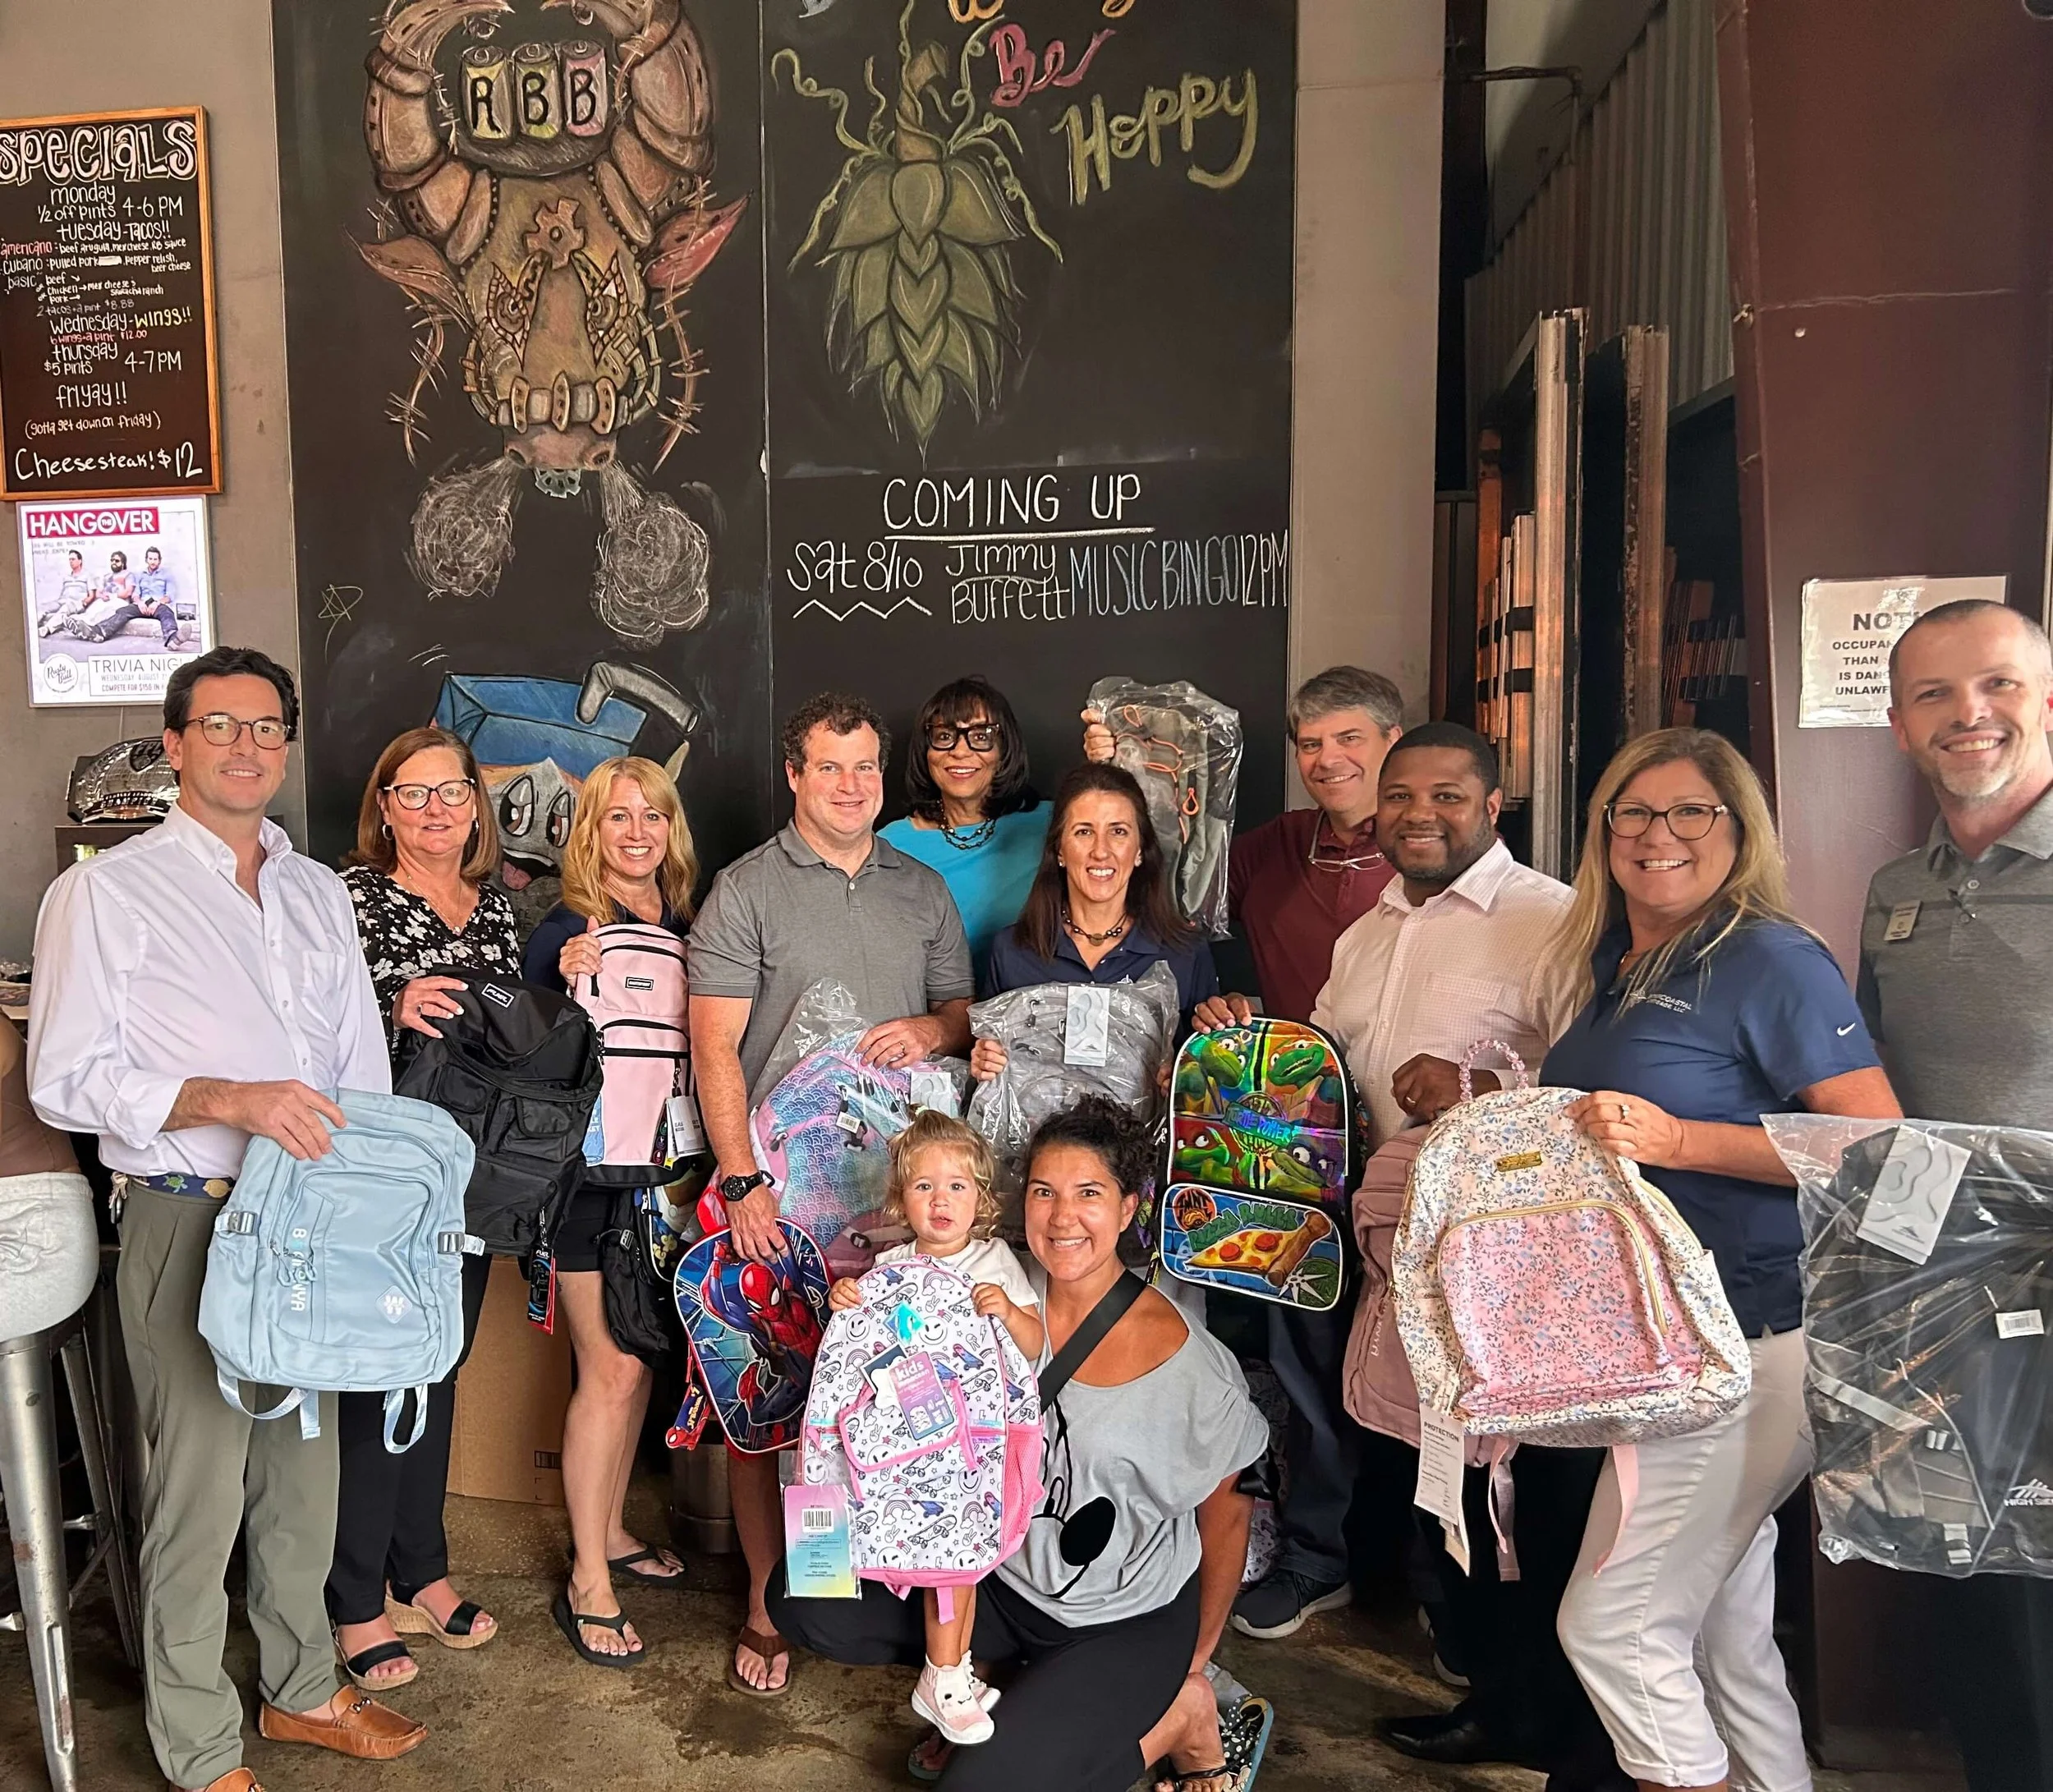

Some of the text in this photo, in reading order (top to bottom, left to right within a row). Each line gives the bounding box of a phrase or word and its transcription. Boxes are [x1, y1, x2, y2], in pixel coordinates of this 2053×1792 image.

[884, 472, 1141, 530] COMING UP
[30, 510, 155, 536] HANGOVER
[863, 540, 924, 593] 8/10
[945, 543, 1056, 584] Jimmy
[1070, 540, 1157, 617] MUSIC
[1161, 535, 1239, 611] BINGO
[1853, 611, 1920, 631] NOT
[92, 656, 188, 673] TRIVIA NIG
[1843, 655, 1879, 665] THAN
[1839, 672, 1851, 681] IS
[1835, 685, 1890, 696] UNLAWF
[1423, 1422, 1460, 1442] PROTECTION
